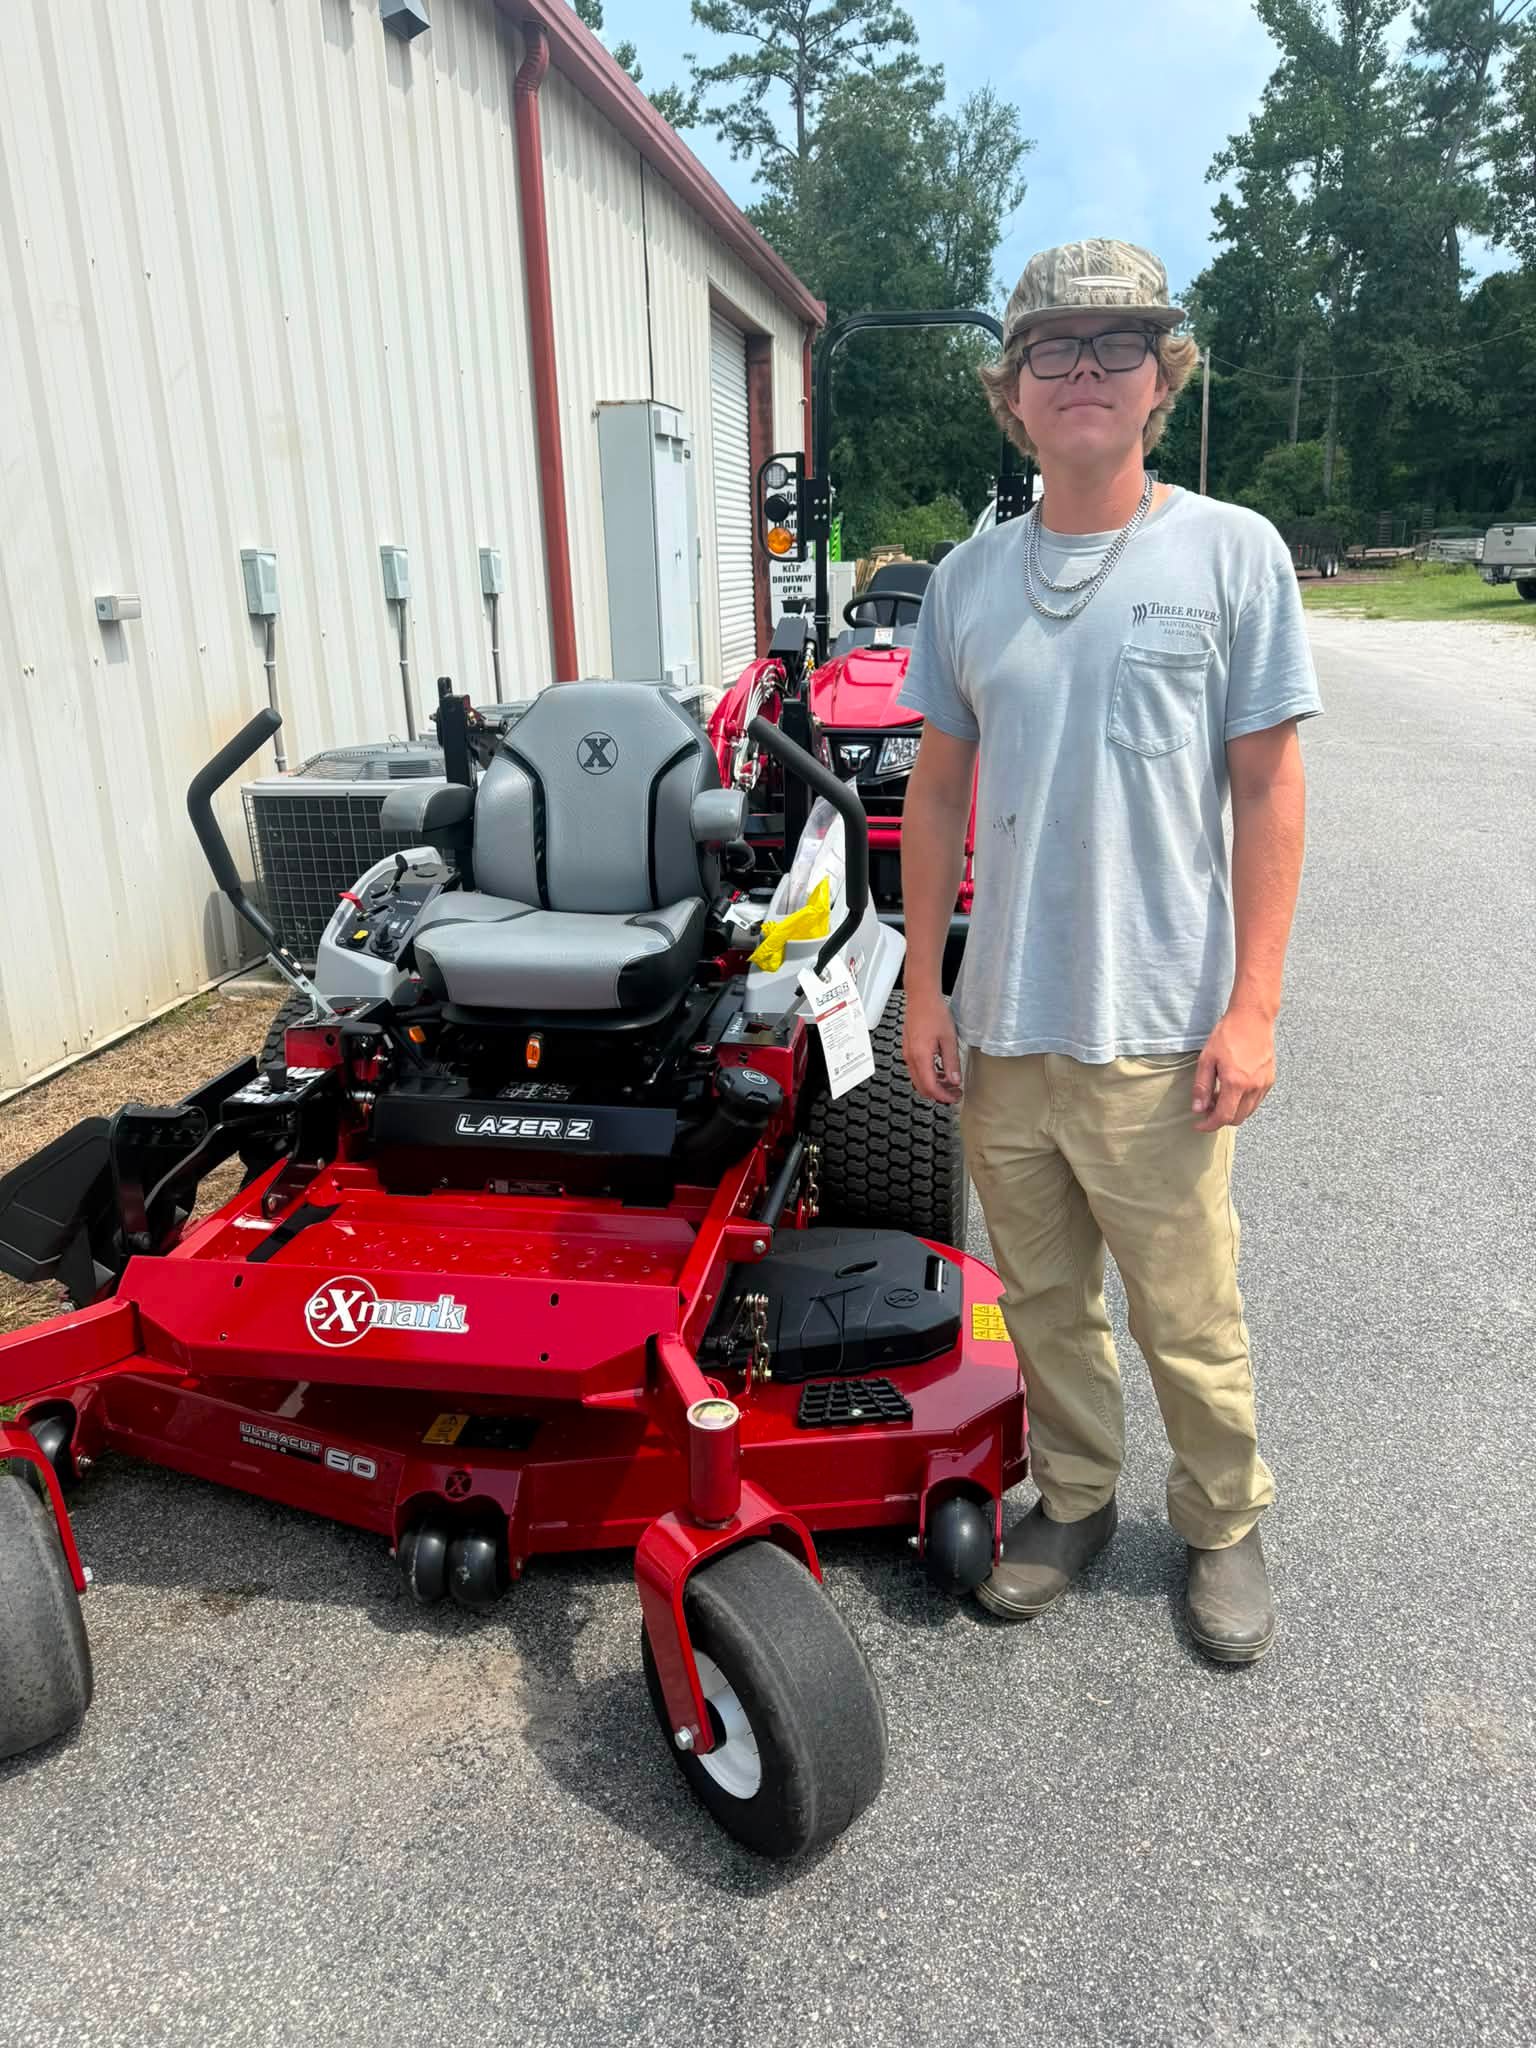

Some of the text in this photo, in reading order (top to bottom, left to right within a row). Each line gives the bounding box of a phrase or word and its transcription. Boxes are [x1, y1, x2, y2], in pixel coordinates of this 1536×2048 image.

[782, 564, 801, 573] KEEP
[772, 575, 812, 584] DRIVEWAY
[782, 585, 802, 593] OPEN
[1148, 602, 1221, 623] THREE RIVERS
[457, 1115, 592, 1139] LAZER Z
[240, 1422, 321, 1453] ULTRACUT
[242, 1435, 278, 1451] SERIES
[326, 1447, 377, 1480] 60
